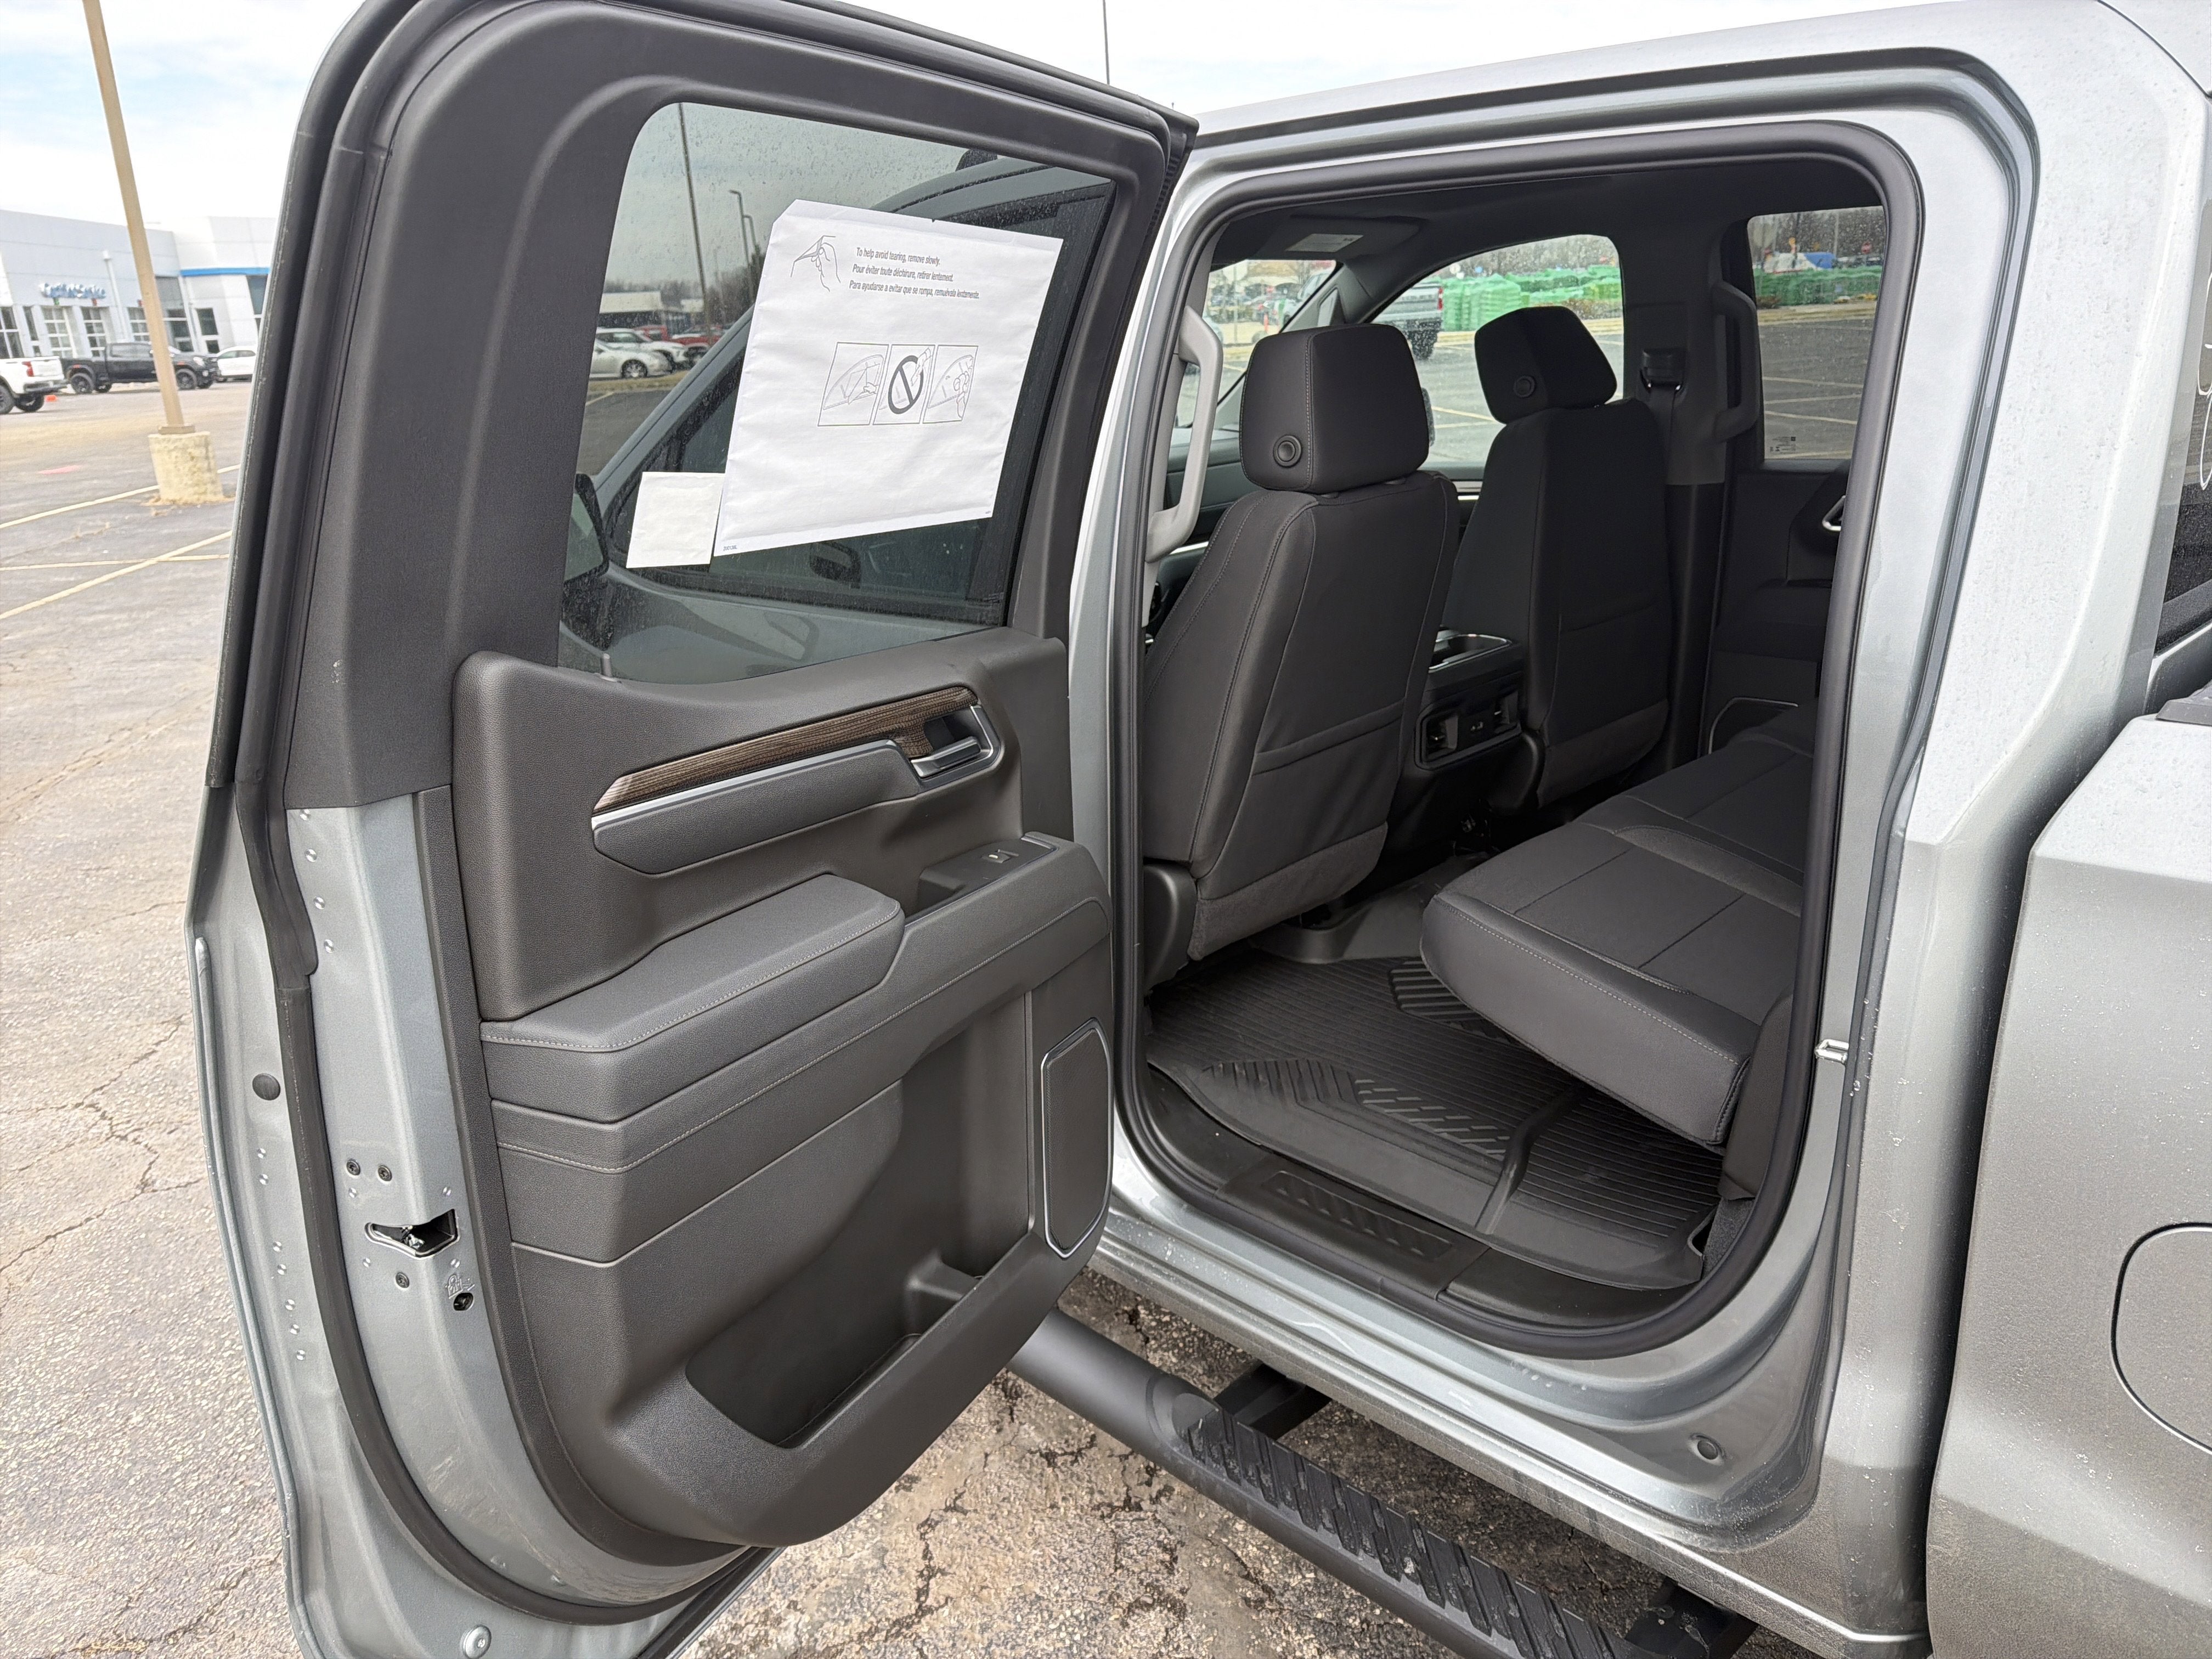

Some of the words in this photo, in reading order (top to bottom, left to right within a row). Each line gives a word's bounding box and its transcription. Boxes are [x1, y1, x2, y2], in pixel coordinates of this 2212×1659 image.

[856, 247, 863, 257] To
[864, 248, 874, 259] help
[875, 250, 889, 259] avoid
[907, 255, 925, 263] remove
[853, 263, 865, 273] Pour
[866, 264, 879, 275] éviter
[880, 267, 893, 276] toute
[849, 280, 861, 289] Para
[862, 282, 884, 291] ayudarse
[889, 284, 903, 292] evitar
[903, 286, 912, 295] que
